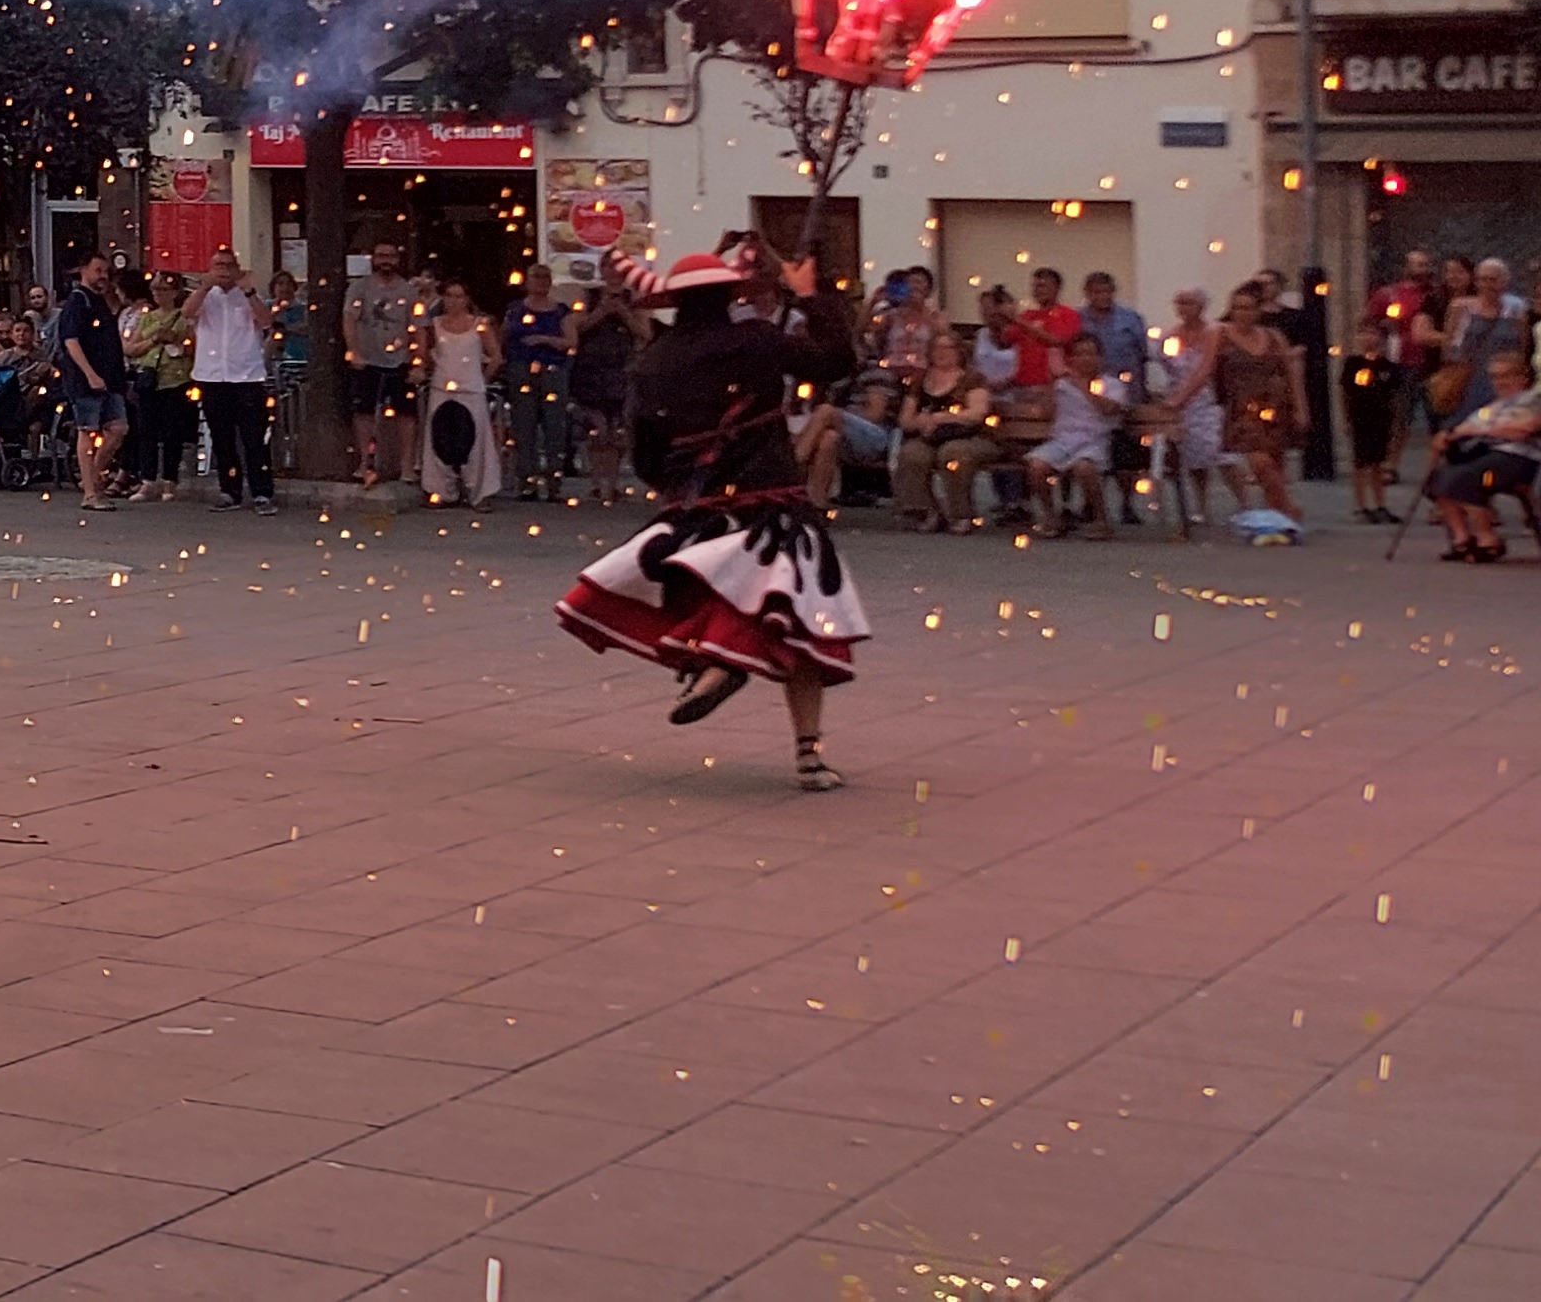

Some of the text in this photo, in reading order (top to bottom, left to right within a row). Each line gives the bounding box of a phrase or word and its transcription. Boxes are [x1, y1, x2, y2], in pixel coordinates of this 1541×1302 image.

[1344, 54, 1427, 92] BAR
[258, 124, 284, 144] Taj
[428, 122, 524, 142] Restaurant
